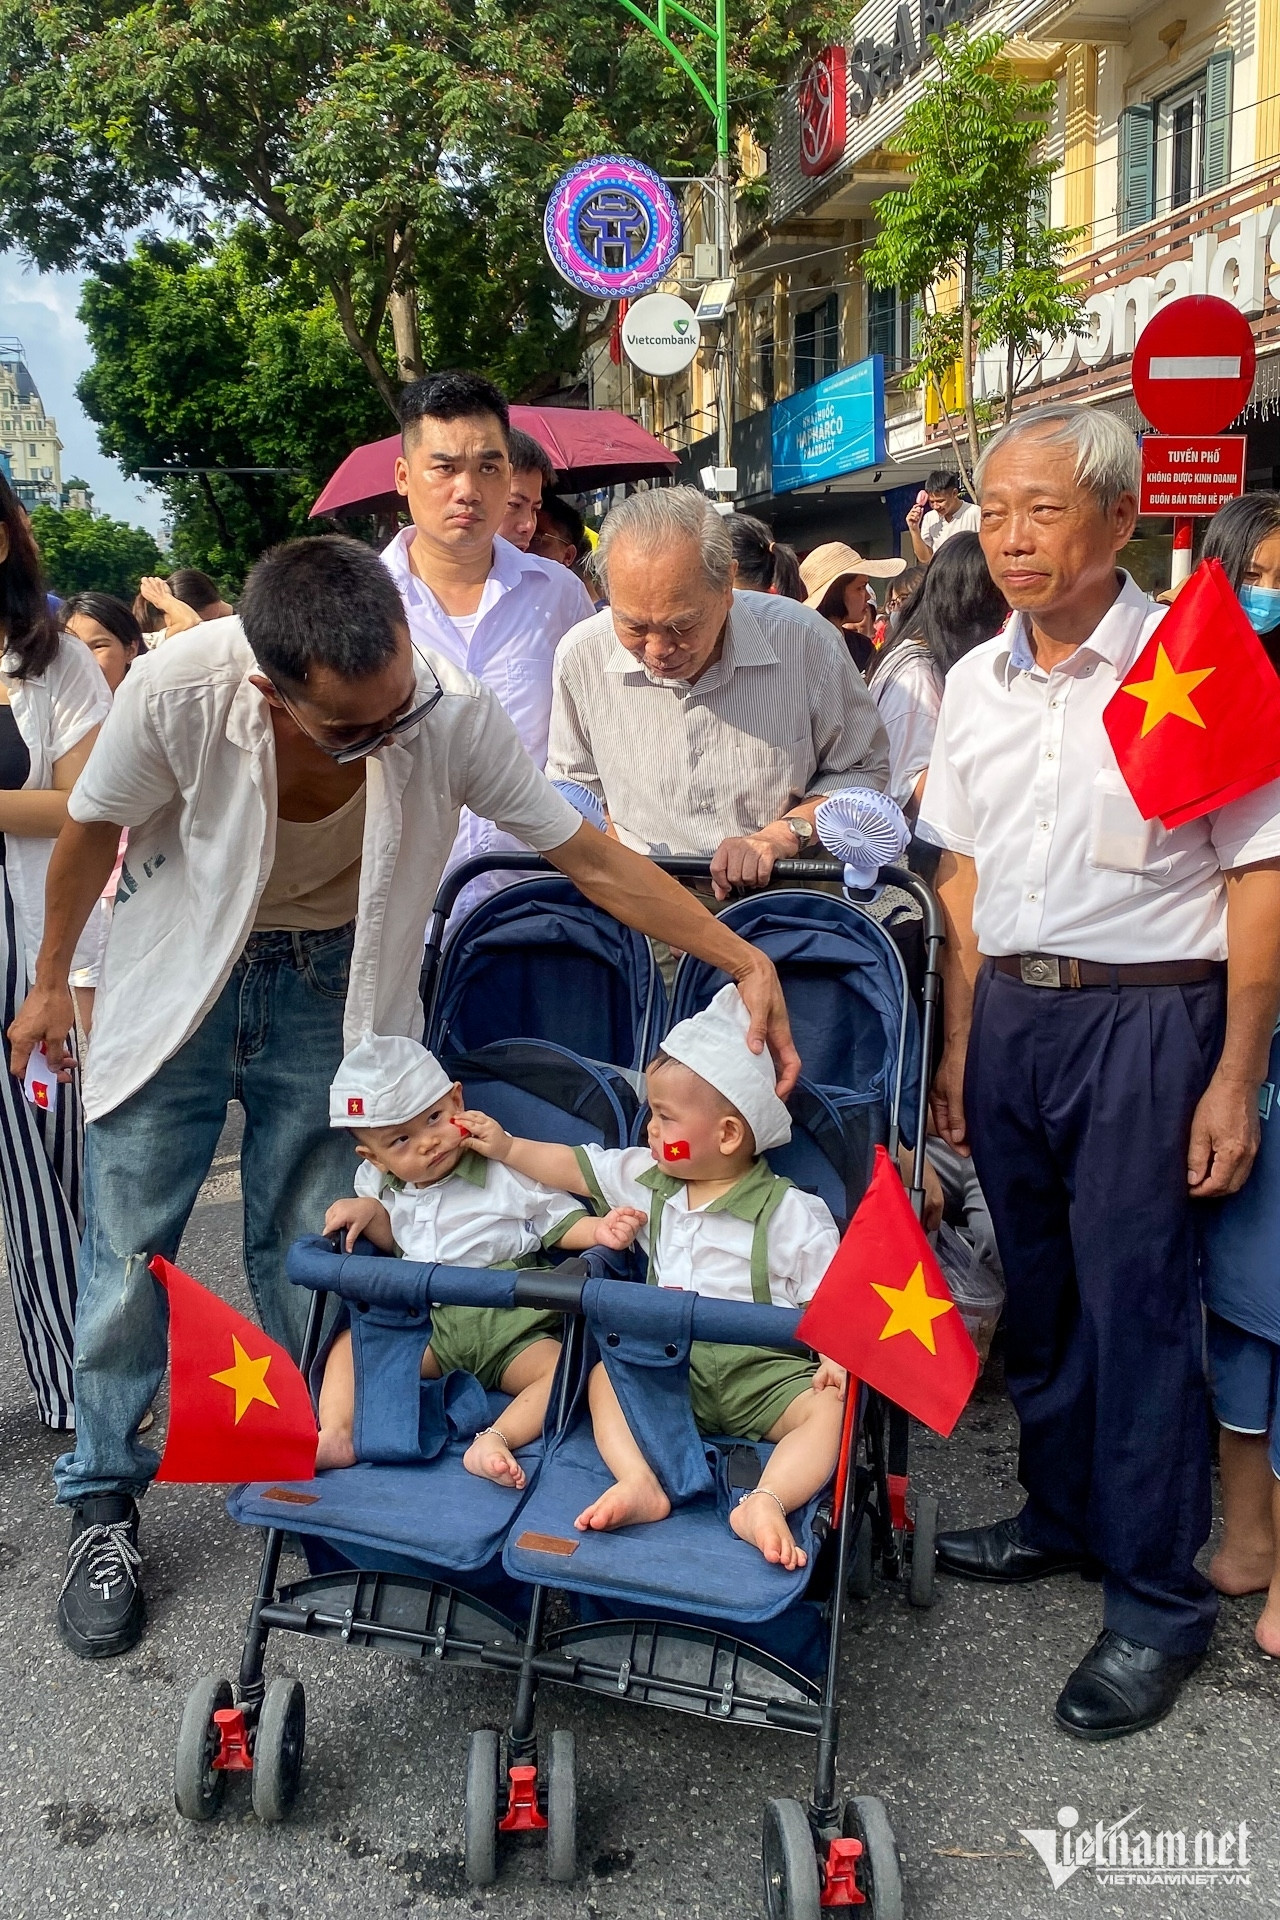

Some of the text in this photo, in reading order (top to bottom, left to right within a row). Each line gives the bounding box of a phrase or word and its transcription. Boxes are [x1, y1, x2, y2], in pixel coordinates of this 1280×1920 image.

[627, 335, 697, 345] Vietcombank
[796, 415, 843, 450] HAPHARCO
[1168, 447, 1221, 463] TUYẾN PHỐ
[1146, 471, 1237, 485] KHÔNG ĐƯỢC KINH DOANH
[1150, 493, 1170, 504] BUÔN
[1171, 493, 1187, 505] BÁN
[1188, 493, 1207, 505] TRÊN
[1208, 493, 1218, 505] HÈ
